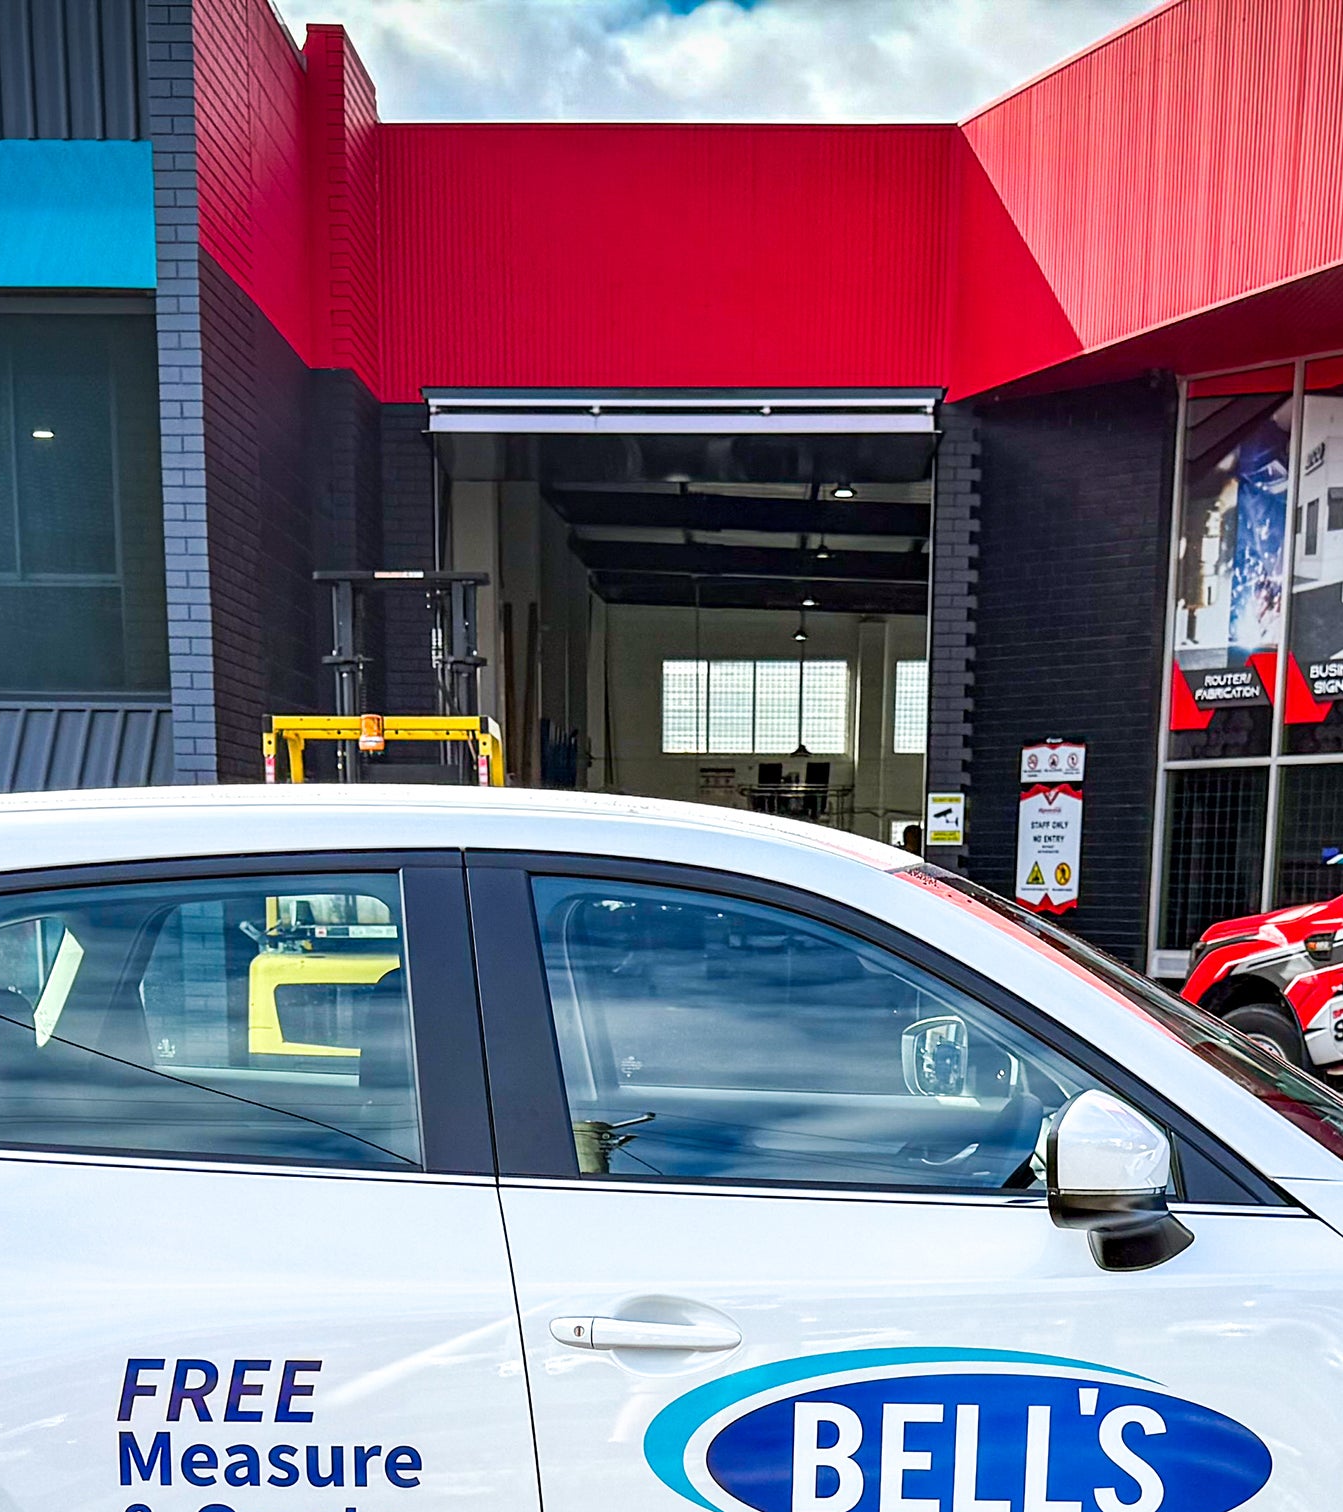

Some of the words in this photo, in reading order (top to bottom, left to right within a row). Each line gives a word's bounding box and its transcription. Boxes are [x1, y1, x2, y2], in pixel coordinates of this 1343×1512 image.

[1194, 684, 1261, 701] FABRICATION
[116, 1357, 323, 1423] FREE
[118, 1431, 423, 1489] Measure
